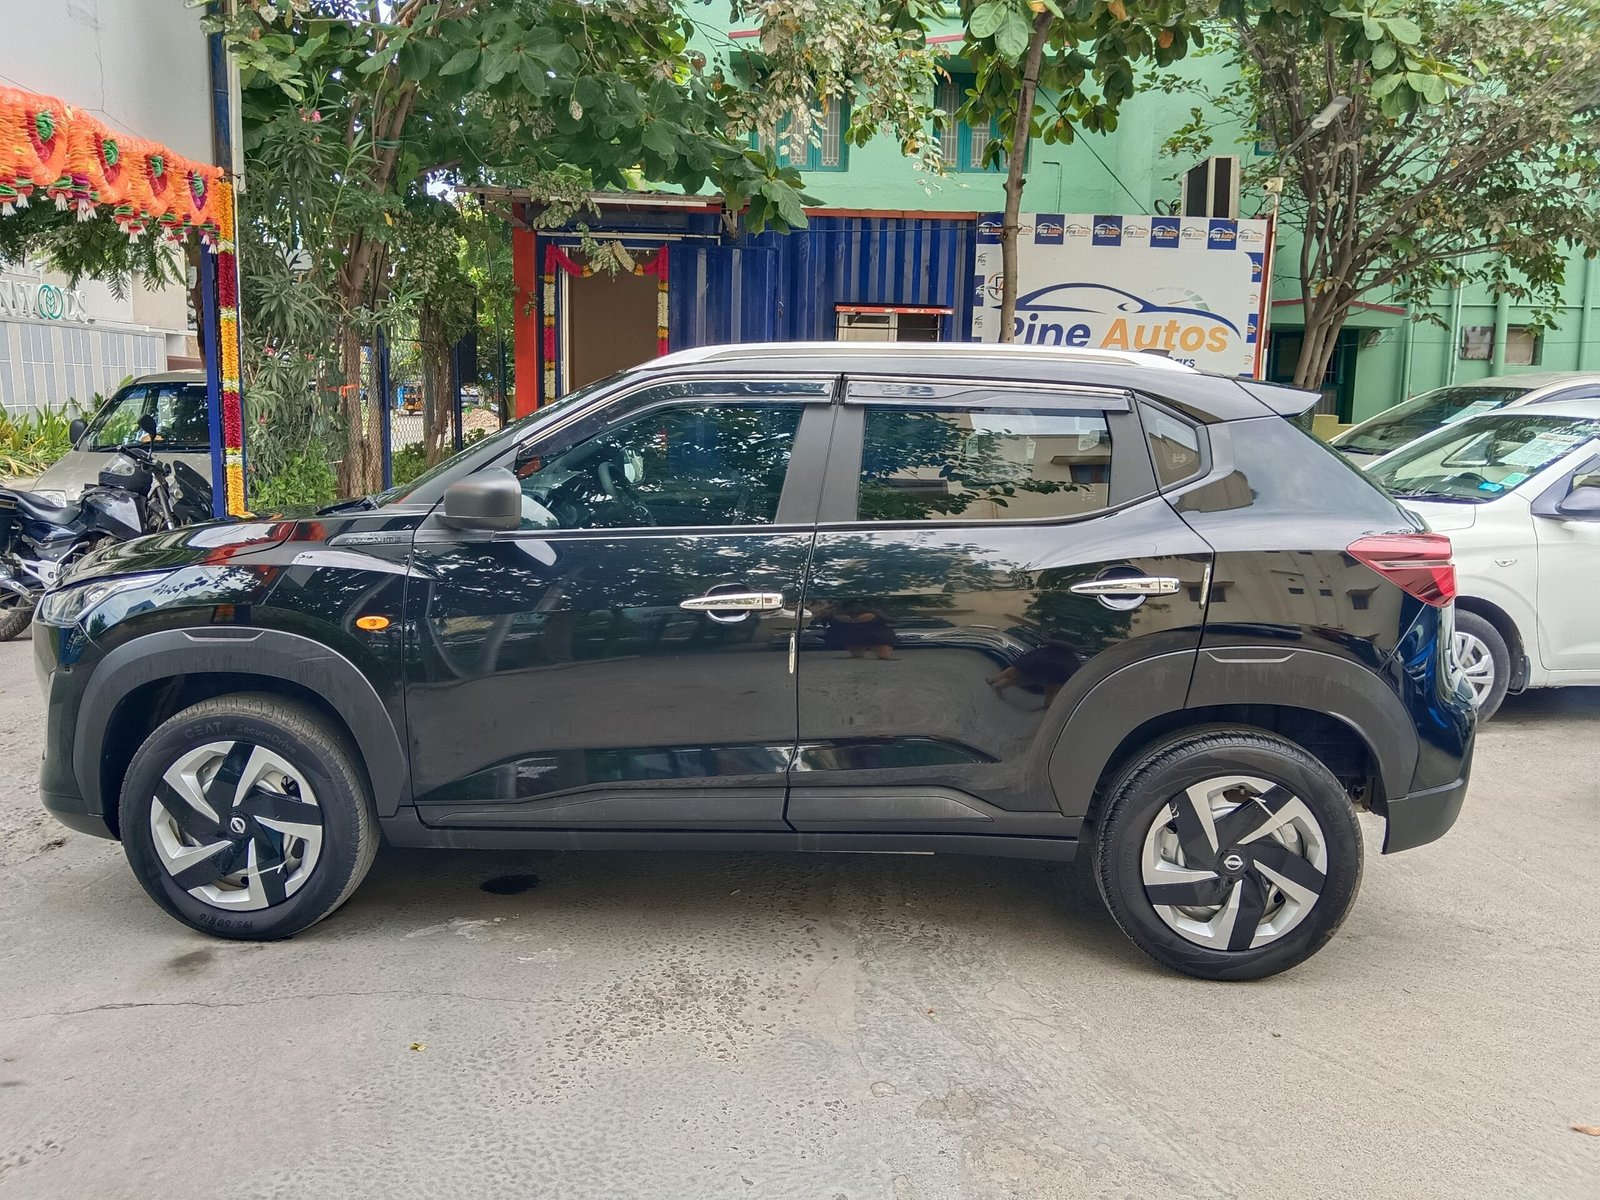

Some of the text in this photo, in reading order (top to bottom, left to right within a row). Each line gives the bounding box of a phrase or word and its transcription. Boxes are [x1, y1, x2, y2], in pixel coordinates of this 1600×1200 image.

[1100, 318, 1229, 352] Autos
[1168, 356, 1196, 369] ars
[184, 722, 222, 739] CEAT
